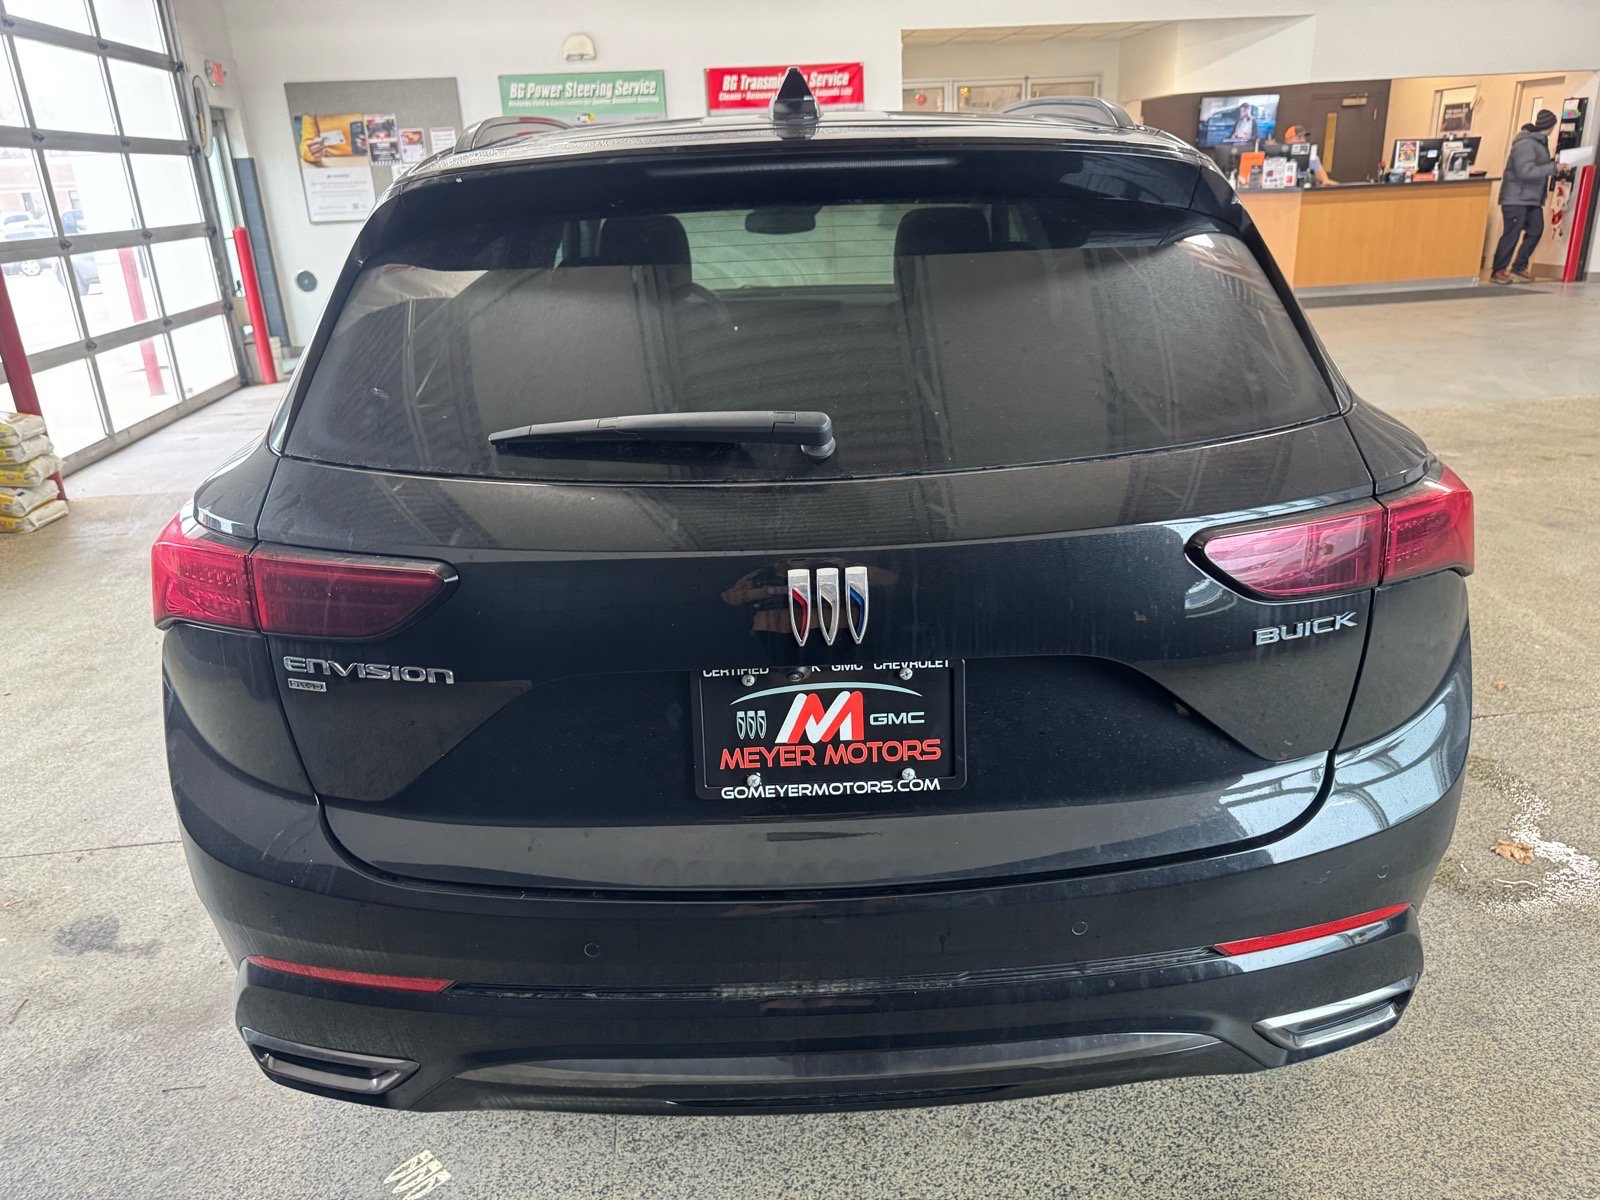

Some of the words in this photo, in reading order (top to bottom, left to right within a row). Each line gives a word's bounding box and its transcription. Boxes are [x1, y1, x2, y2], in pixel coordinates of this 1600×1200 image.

[510, 82, 526, 99] BG
[527, 82, 564, 99] Power
[564, 80, 614, 99] Steering
[615, 79, 657, 96] Service
[722, 74, 738, 91] BG
[809, 70, 850, 88] Service
[1253, 611, 1358, 646] BUICK
[283, 655, 455, 685] ENVISION
[869, 711, 925, 726] GMC
[719, 743, 816, 770] MEYER
[824, 738, 942, 765] MOTORS
[720, 777, 941, 800] GOMEYERMOTORS.COM
